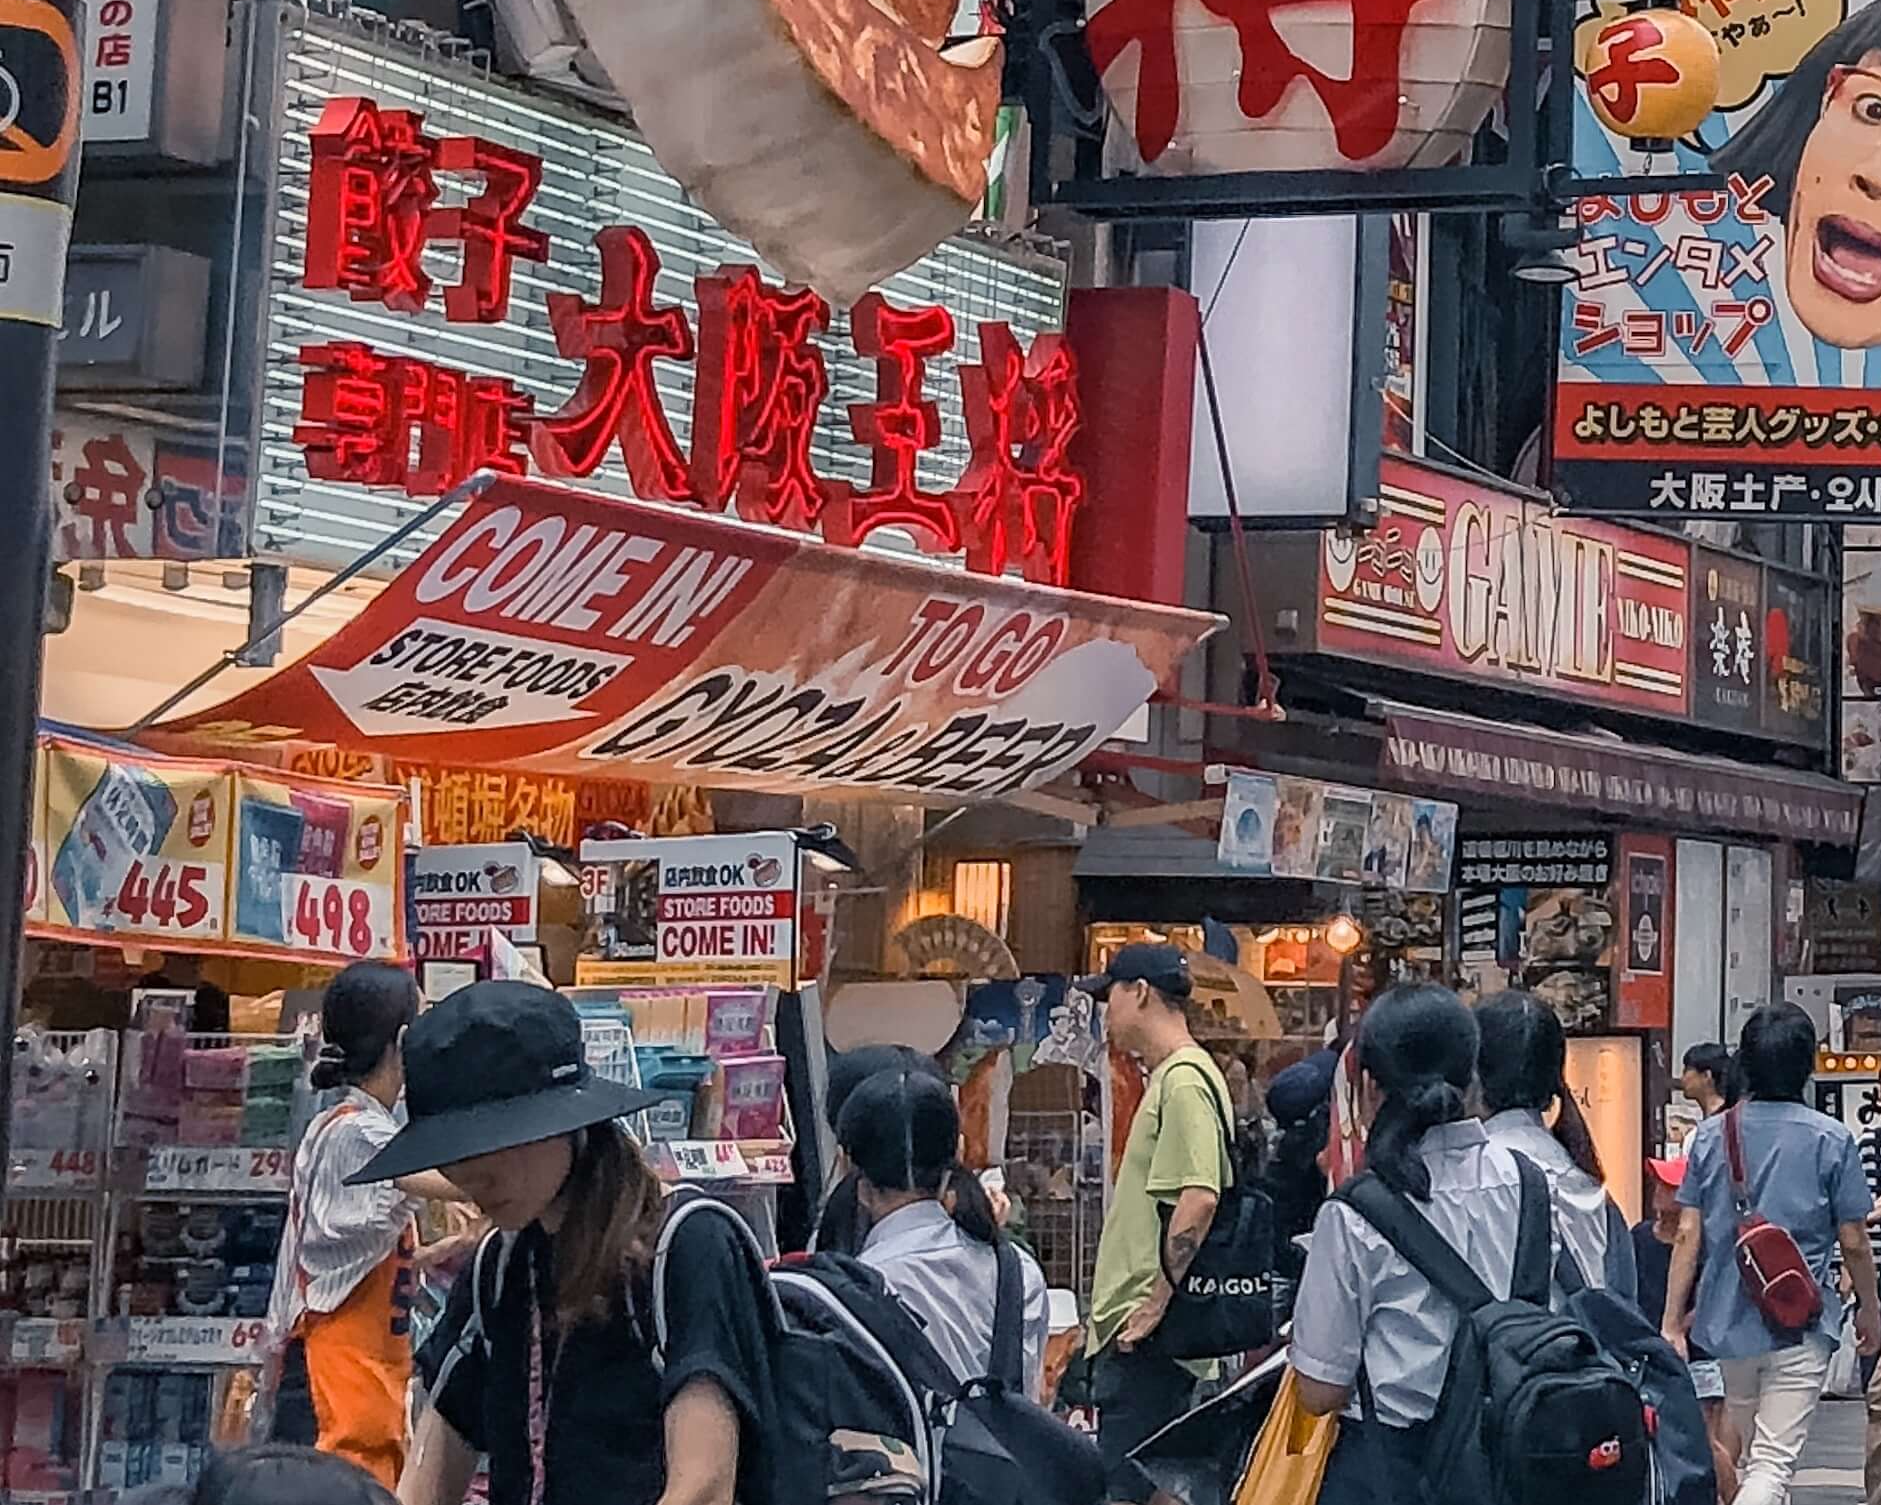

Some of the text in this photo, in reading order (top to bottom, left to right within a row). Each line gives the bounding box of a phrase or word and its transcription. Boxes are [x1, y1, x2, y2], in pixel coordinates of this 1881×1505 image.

[92, 80, 129, 115] B1
[302, 96, 550, 324] 餃子
[1576, 235, 1776, 293] エンタメ
[1571, 299, 1775, 358] ショップ
[530, 224, 1082, 586] 大阪王将
[416, 505, 754, 648] COME IN!
[1449, 499, 1615, 686] GAME
[370, 628, 617, 699] STORE FOODS
[881, 598, 1065, 693] TO GO
[117, 859, 209, 929] 445
[295, 880, 373, 956] 498
[455, 900, 513, 922] FOODS
[663, 893, 775, 919] STORE FOODS
[661, 923, 777, 957] COME IN!
